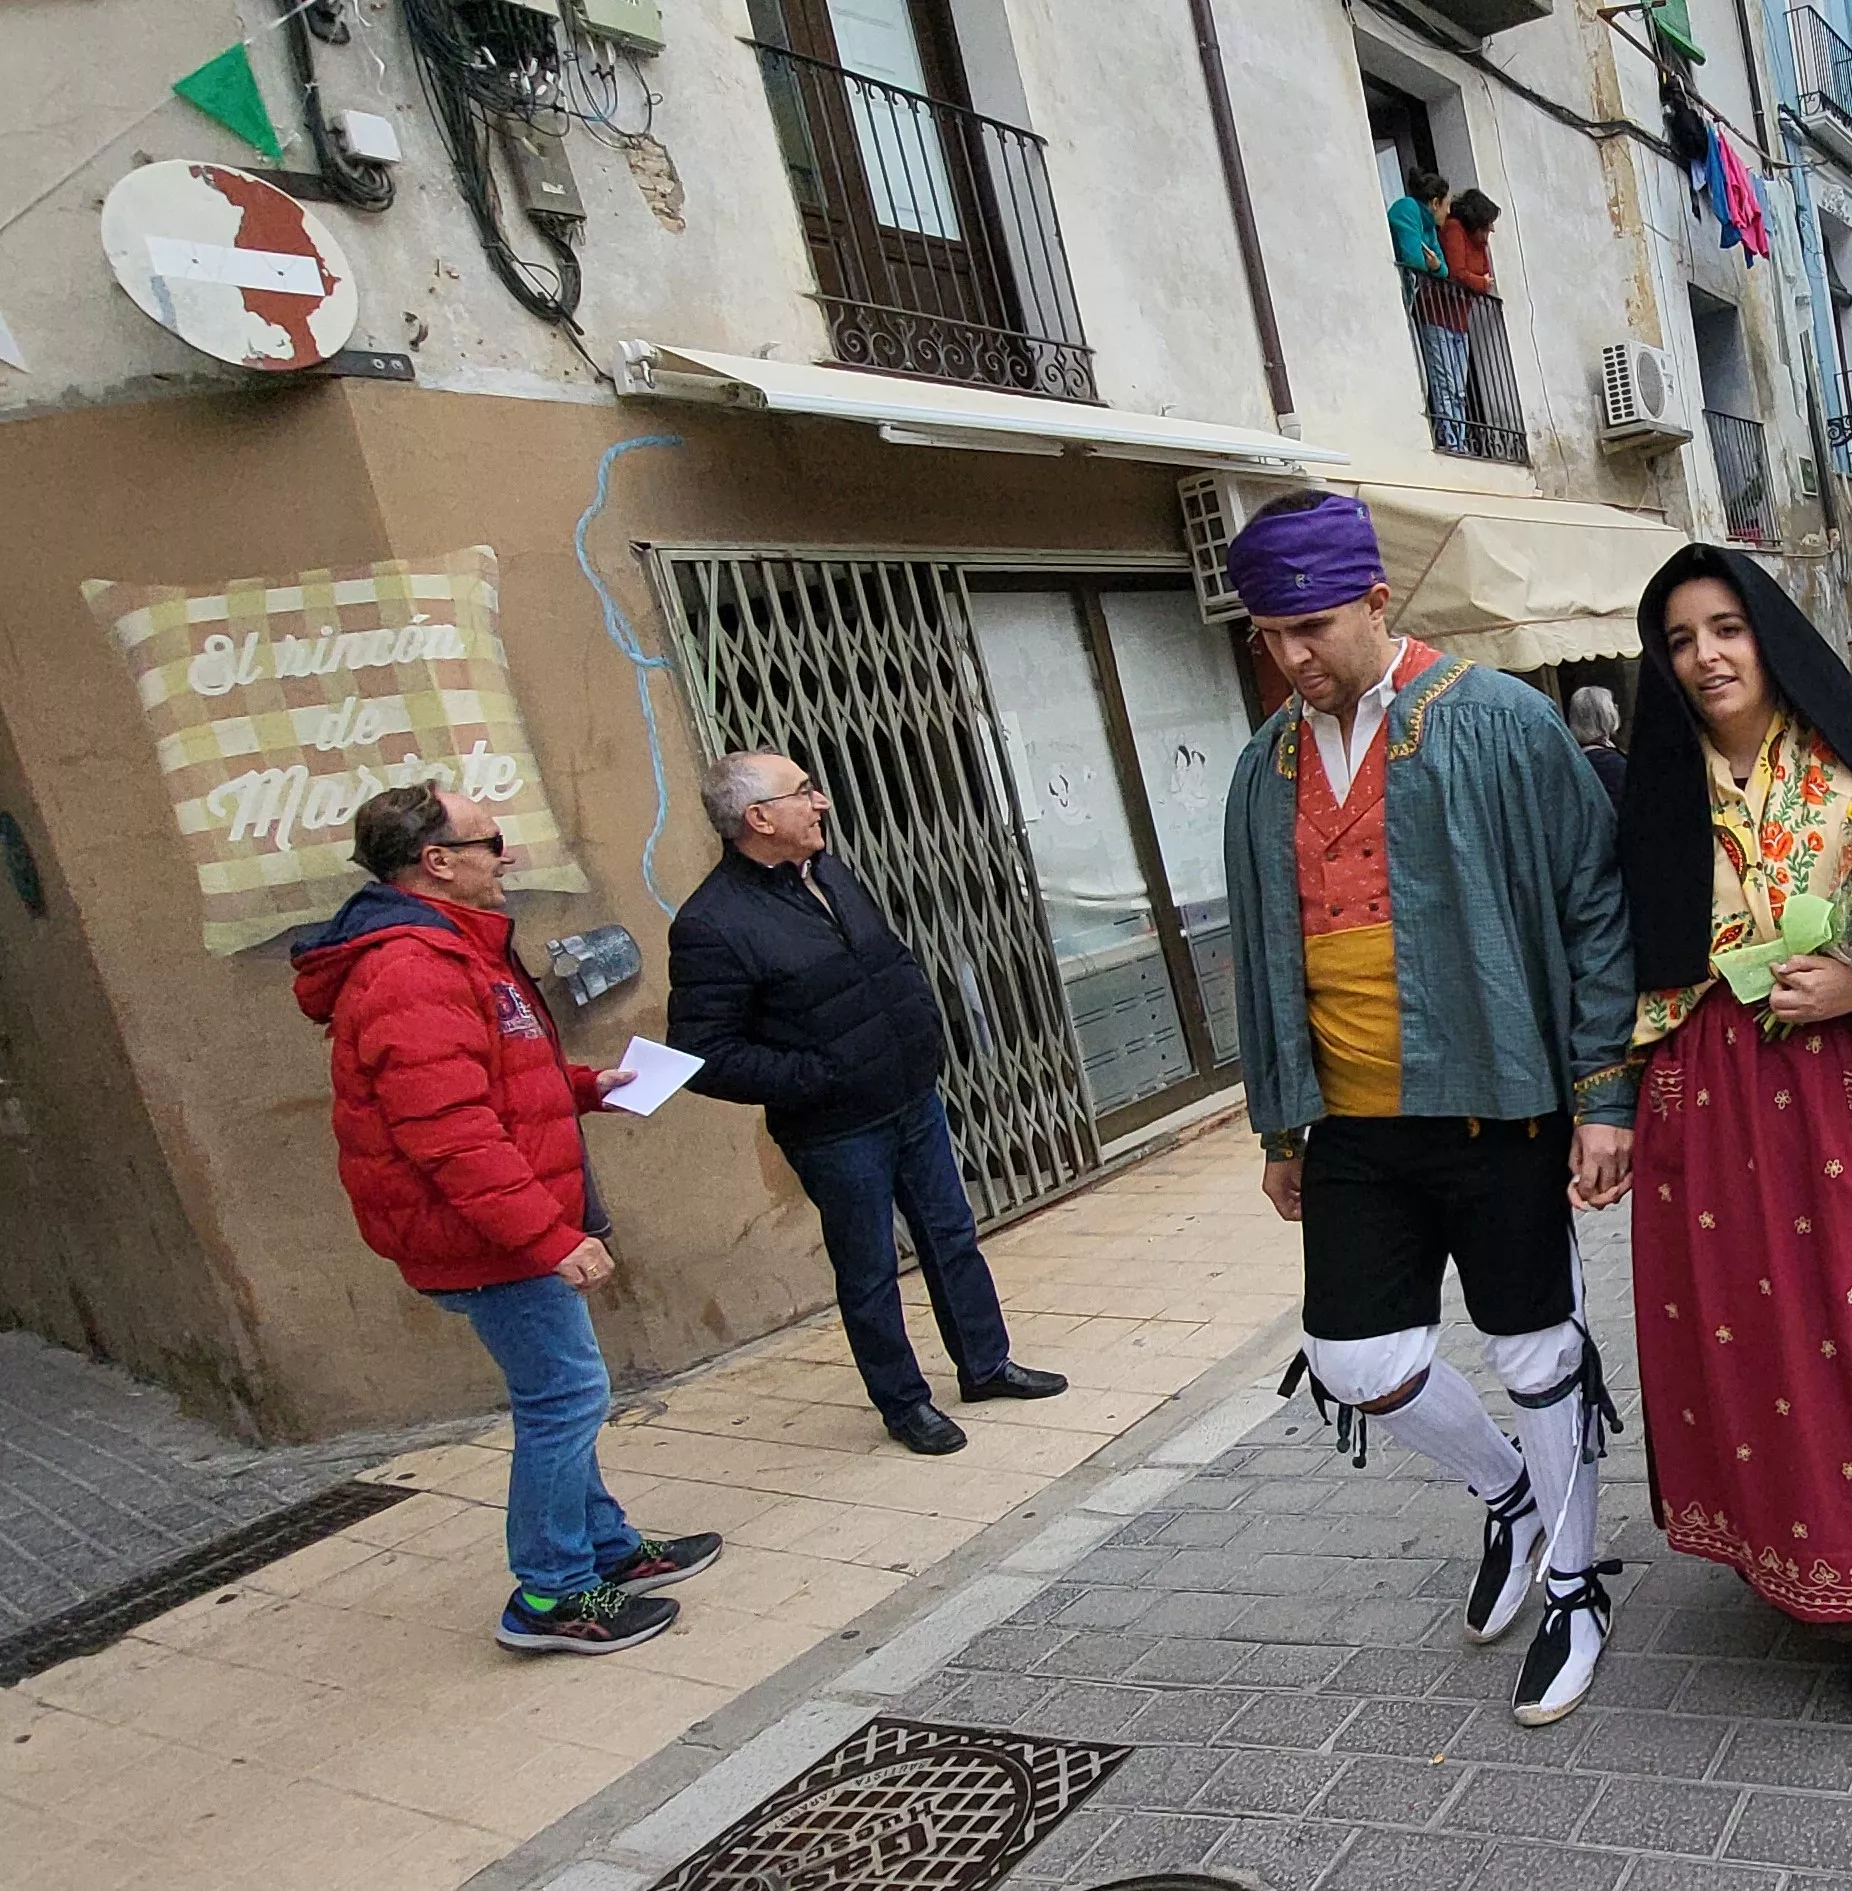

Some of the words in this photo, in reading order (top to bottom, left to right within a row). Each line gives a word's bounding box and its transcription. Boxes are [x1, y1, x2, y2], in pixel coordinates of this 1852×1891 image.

[187, 631, 262, 696] El
[273, 613, 467, 679] rincón
[316, 696, 388, 751] de
[777, 1800, 934, 1875] Huesca
